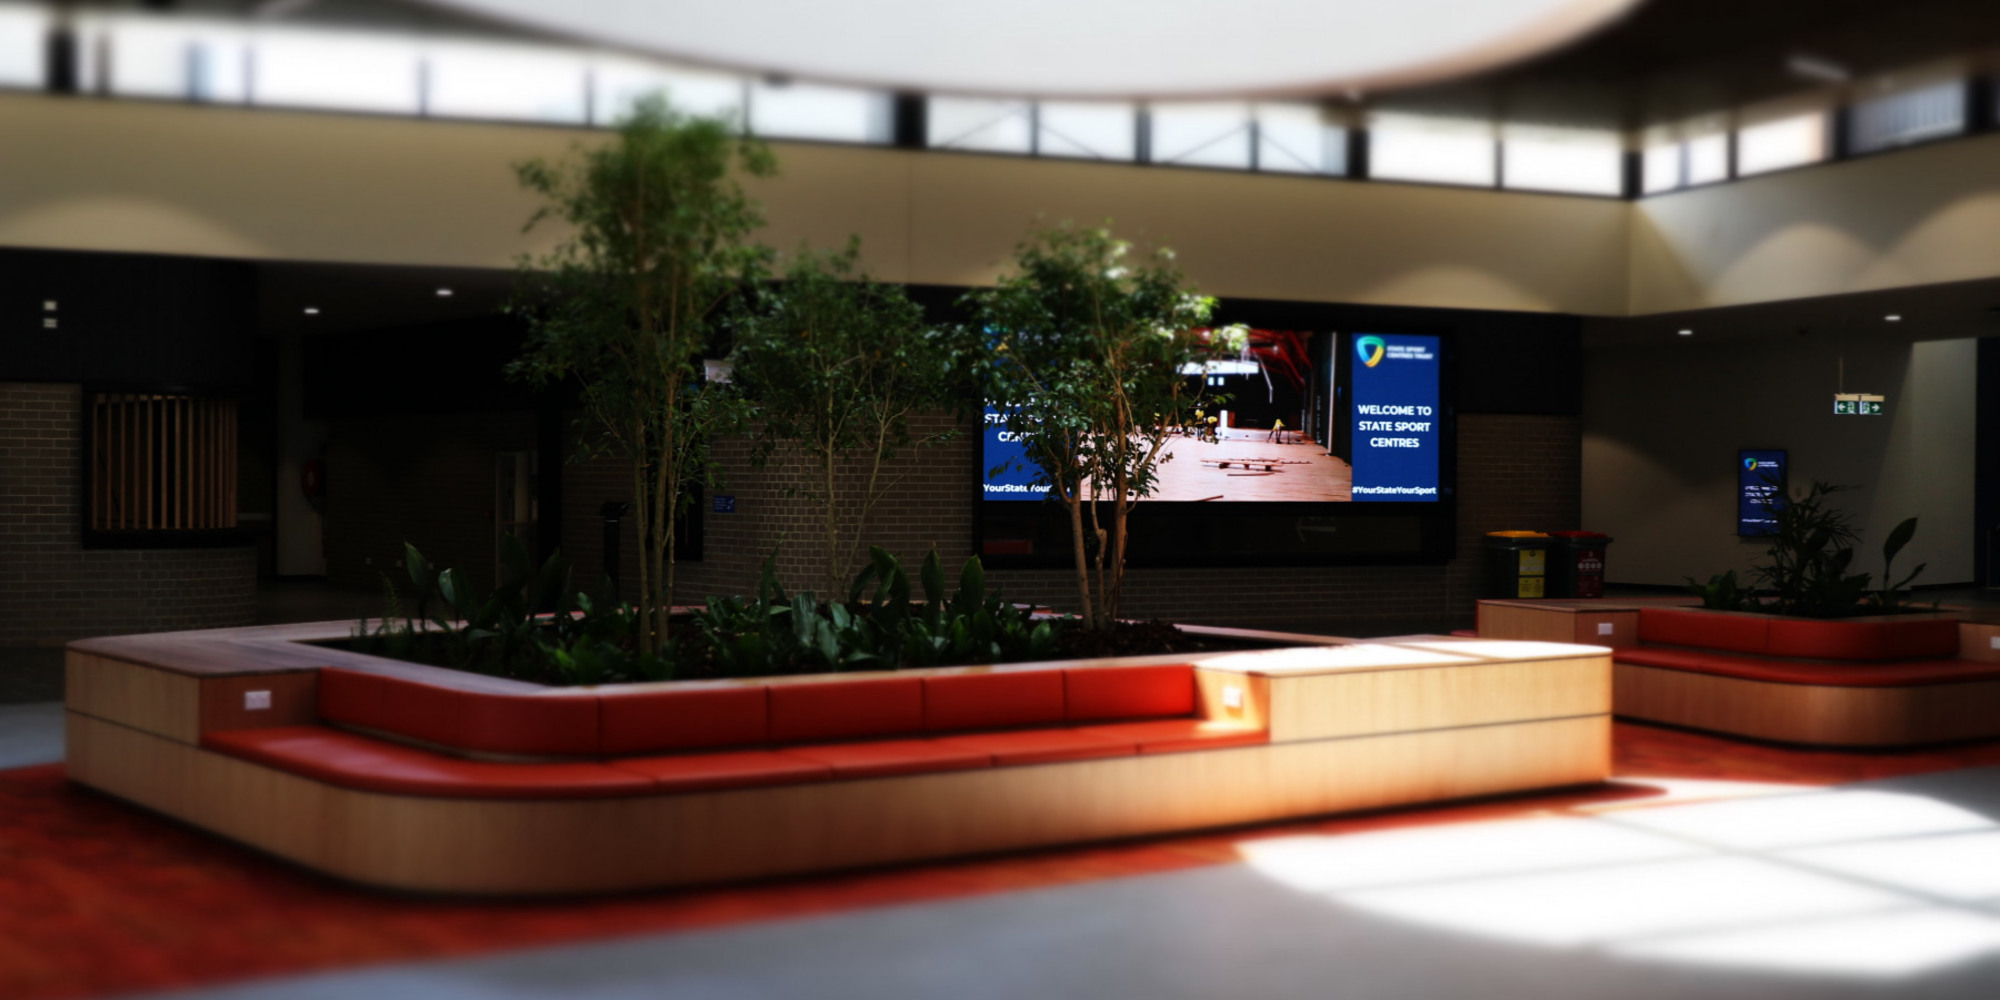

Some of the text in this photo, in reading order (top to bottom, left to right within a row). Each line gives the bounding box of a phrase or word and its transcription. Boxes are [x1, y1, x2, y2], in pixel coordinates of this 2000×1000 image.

[1358, 405, 1432, 416] WELCOME TO
[1358, 420, 1431, 432] STATE SPORT
[1370, 437, 1420, 448] CENTRES
[1352, 486, 1437, 495] #YourStateYourSport
